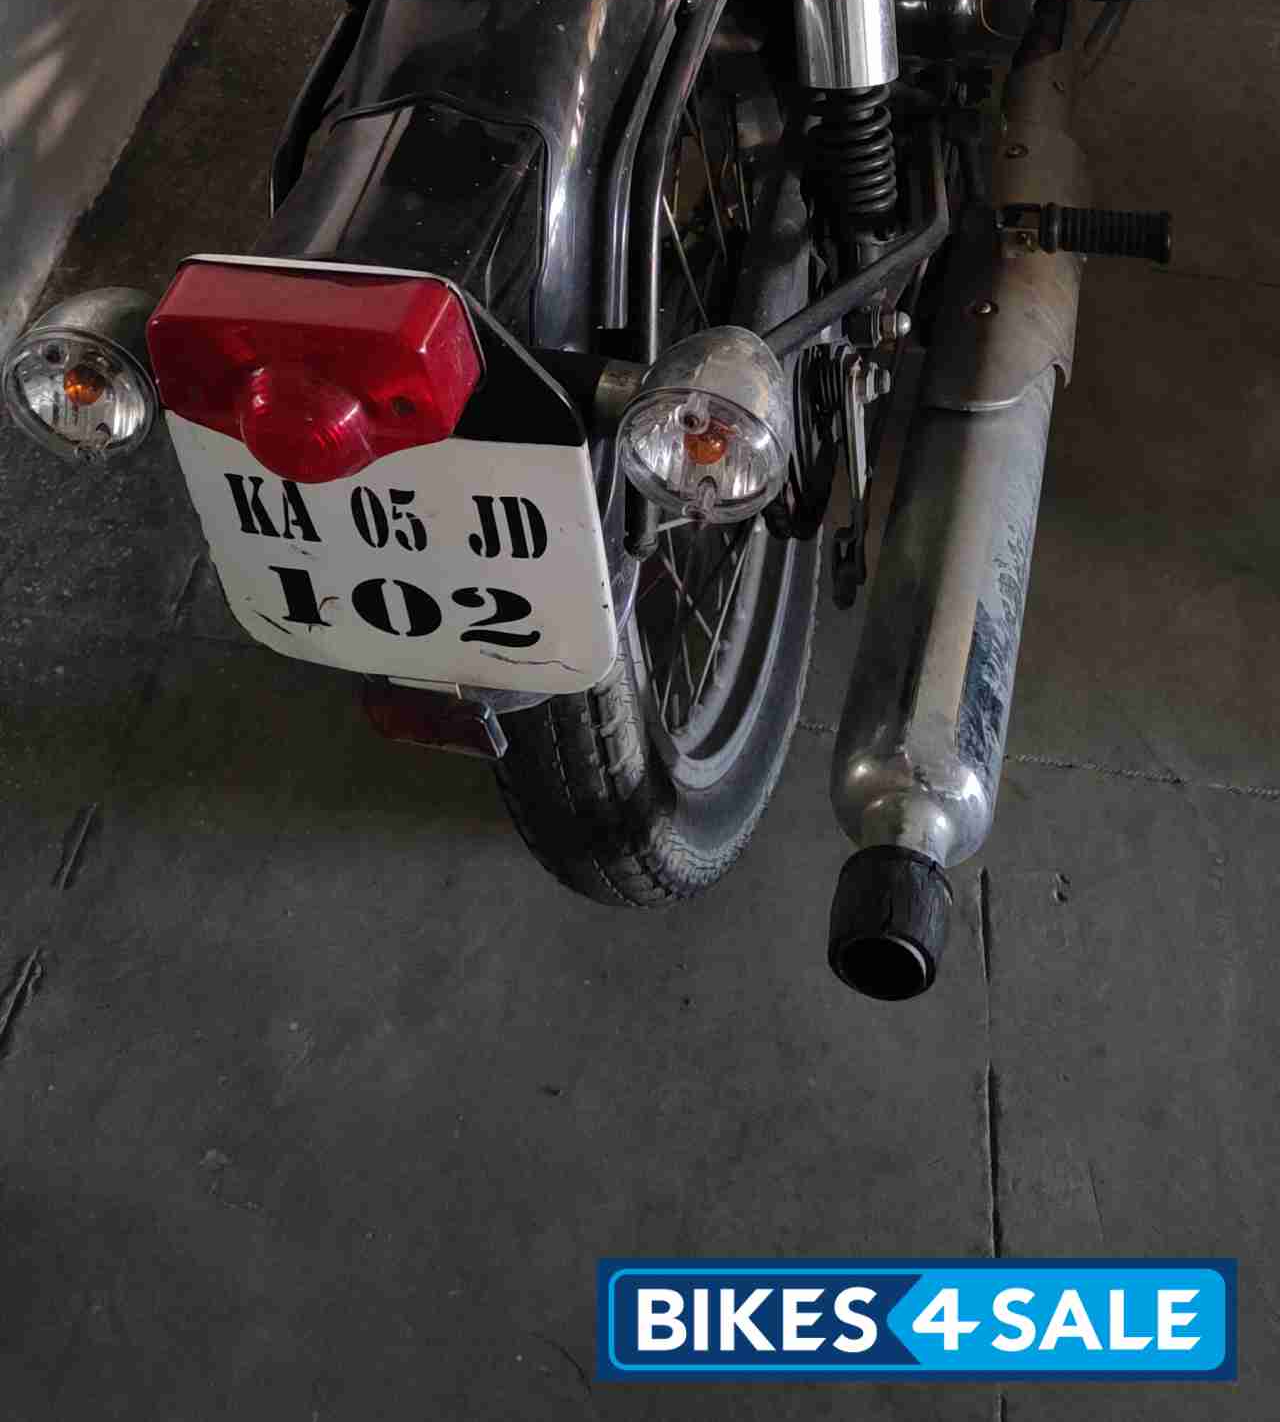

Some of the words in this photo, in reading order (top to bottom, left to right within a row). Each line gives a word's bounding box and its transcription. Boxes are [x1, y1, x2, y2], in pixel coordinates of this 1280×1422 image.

[224, 473, 322, 542] KA
[351, 486, 428, 551] 05
[469, 495, 548, 559] JD
[268, 565, 541, 648] 102
